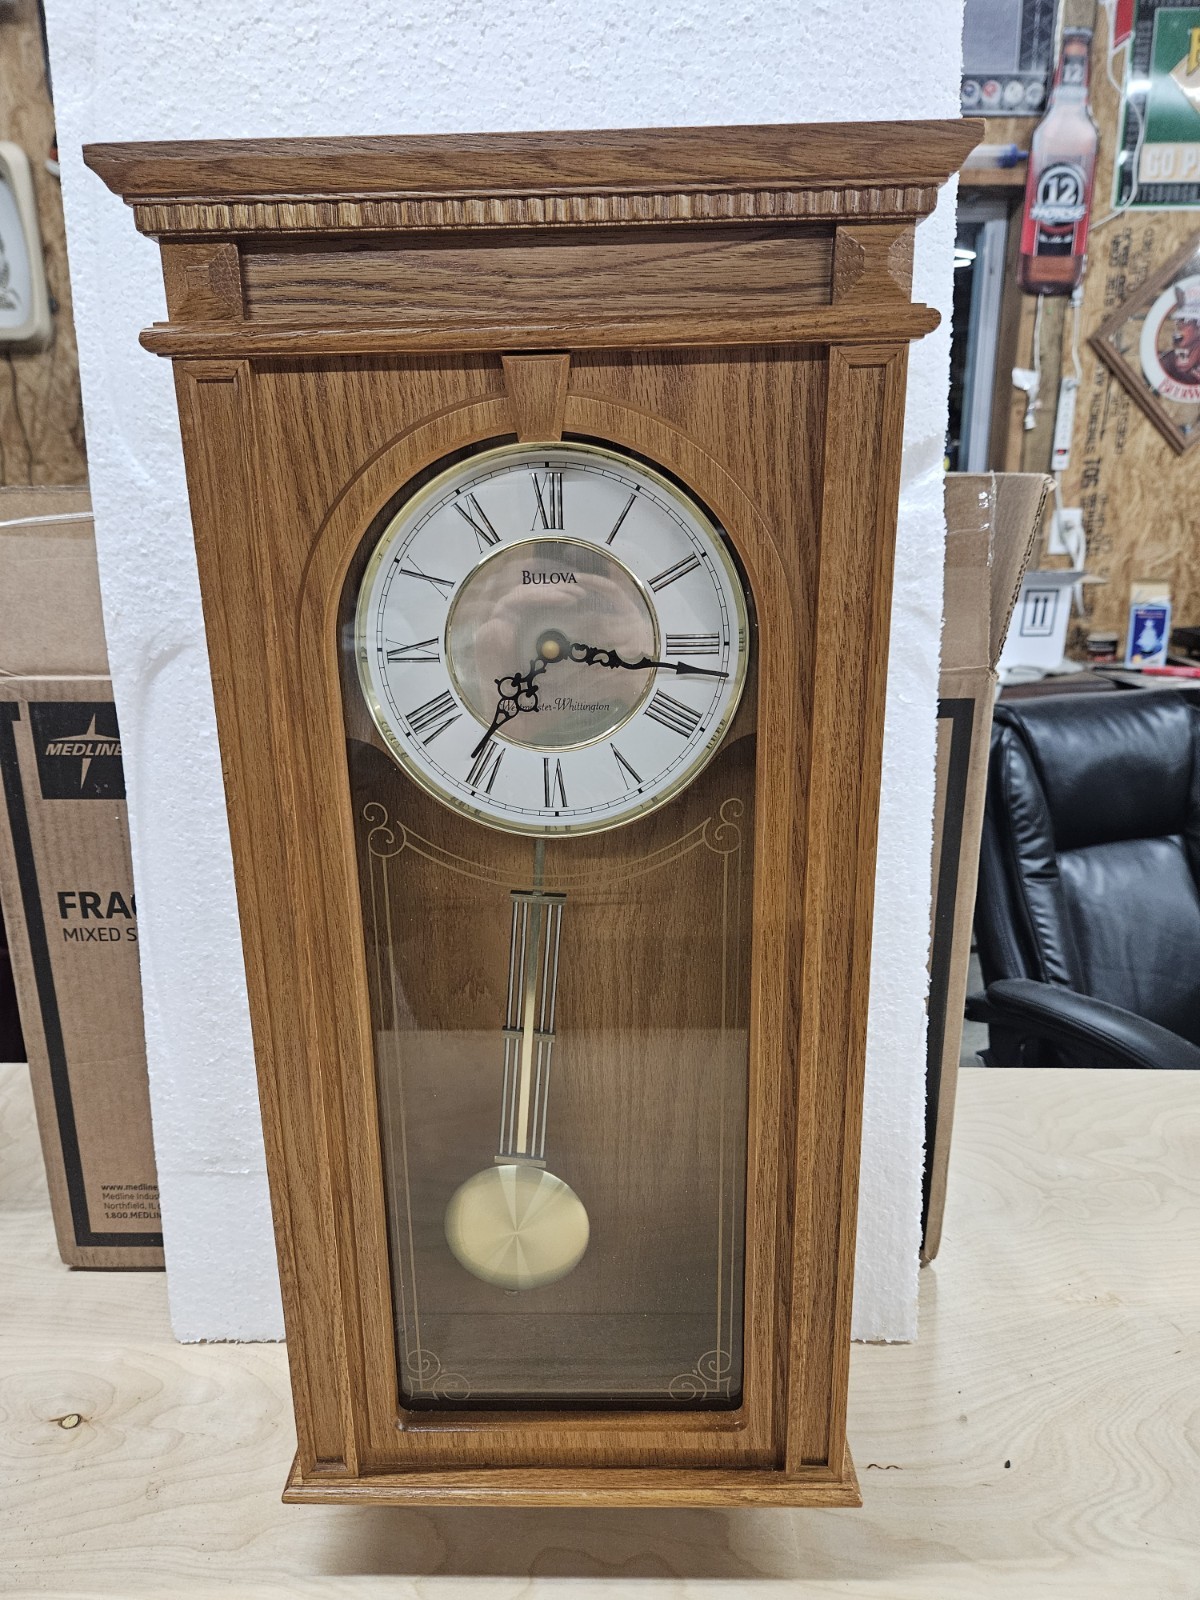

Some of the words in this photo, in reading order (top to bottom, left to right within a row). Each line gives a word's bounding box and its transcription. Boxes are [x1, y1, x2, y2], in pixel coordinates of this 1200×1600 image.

[1045, 177, 1077, 205] 12
[530, 472, 565, 531] XII
[605, 493, 638, 545] I
[451, 492, 503, 554] XI
[399, 554, 456, 601] X
[522, 570, 578, 584] BULOVA
[647, 551, 702, 594] II
[386, 636, 440, 664] IX
[666, 631, 720, 656] III
[404, 689, 463, 747] VIII
[45, 743, 123, 756] MEDLINE
[610, 743, 645, 790] V
[542, 757, 570, 808] VI
[57, 890, 137, 920] FRA
[63, 927, 121, 942] MIXED
[104, 1202, 147, 1210] Northfield,
